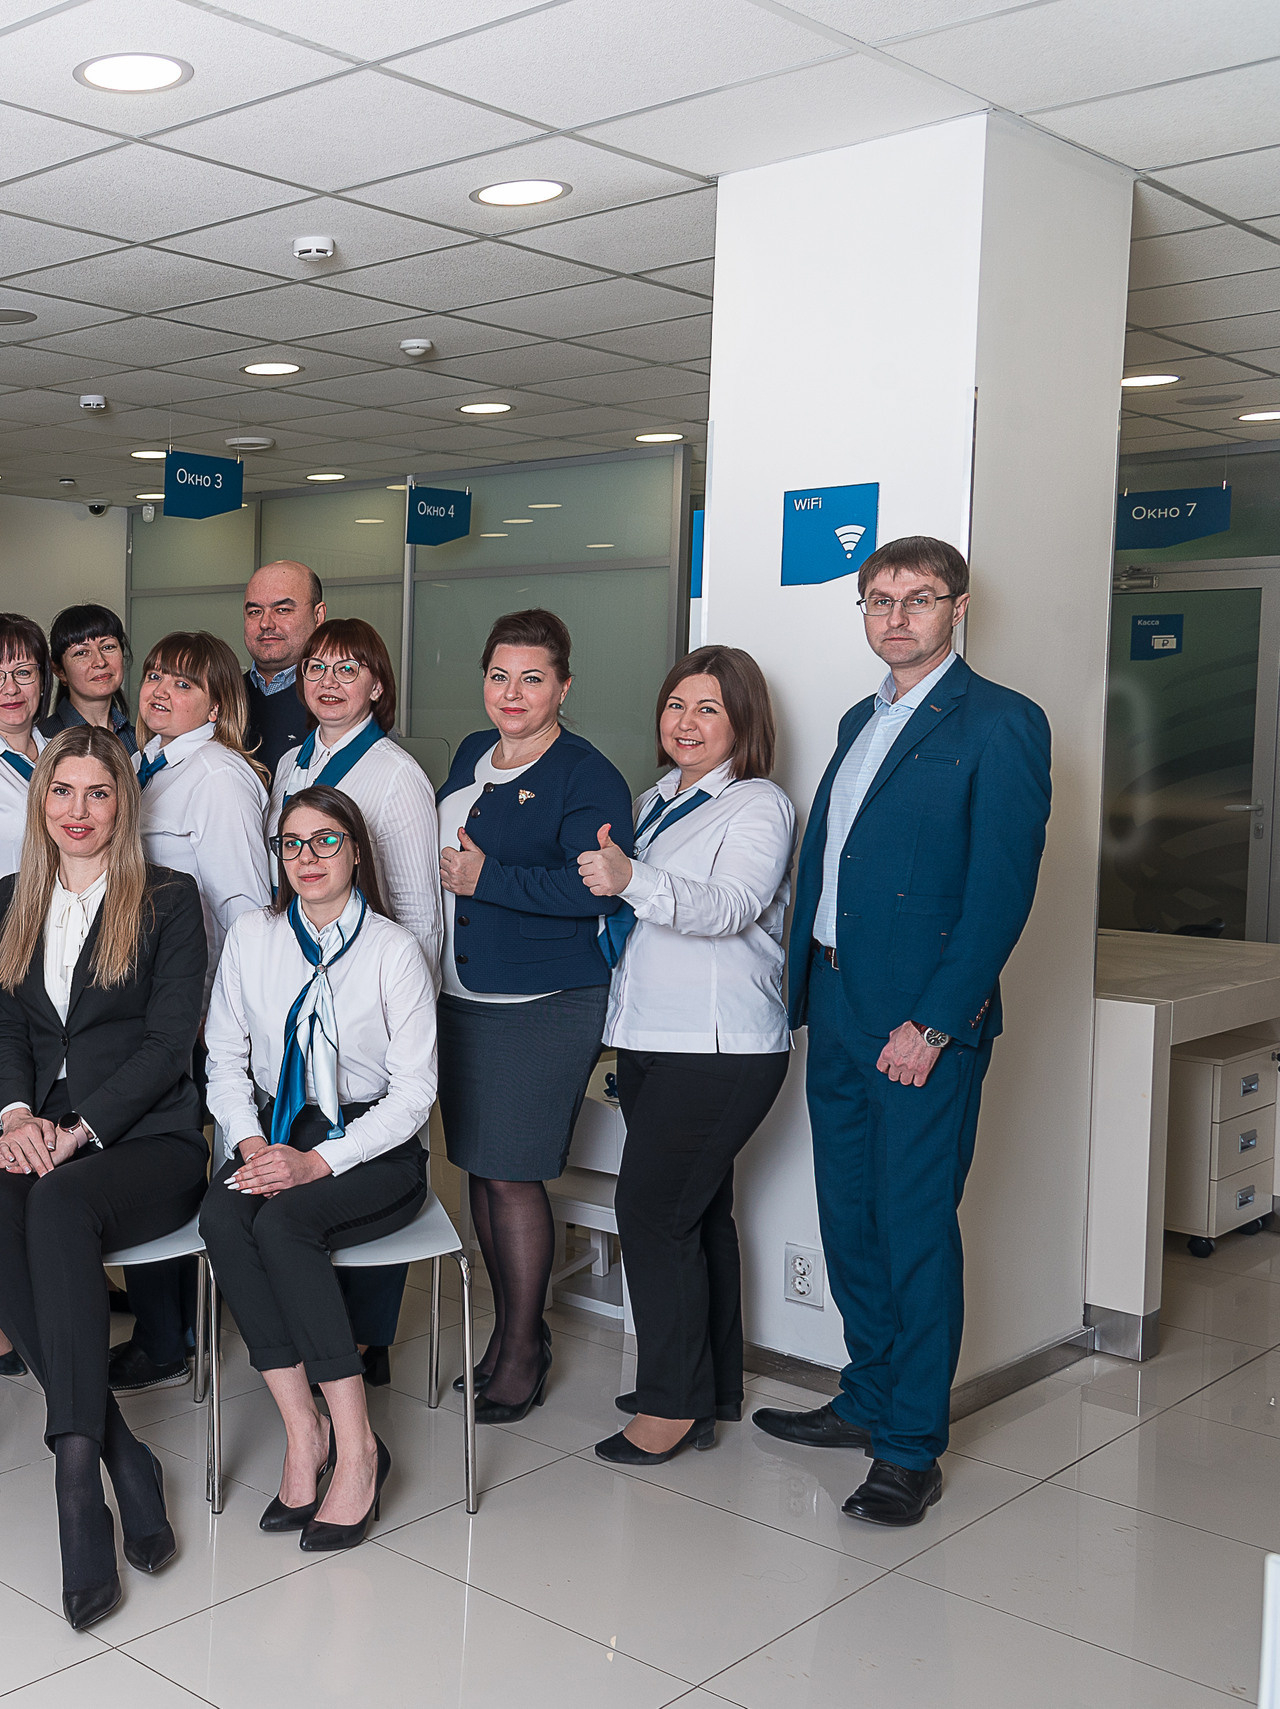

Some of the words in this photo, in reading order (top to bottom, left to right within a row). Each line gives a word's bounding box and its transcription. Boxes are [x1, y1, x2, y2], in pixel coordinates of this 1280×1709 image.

[176, 468, 211, 487] Окно
[214, 473, 223, 489] 3
[417, 501, 446, 517] Окно
[448, 504, 455, 518] 4
[793, 497, 822, 511] WiFi
[1132, 506, 1180, 520] Окно
[1186, 502, 1197, 517] 7
